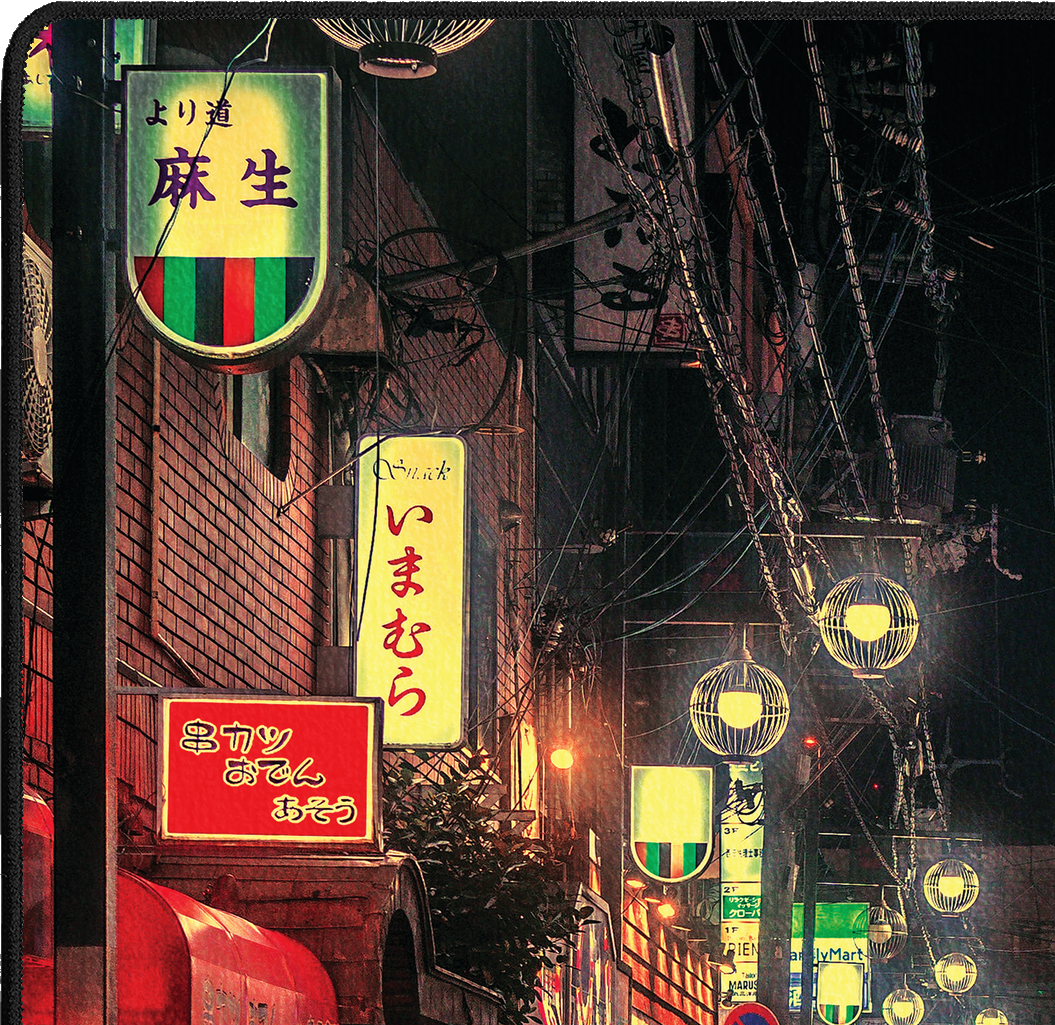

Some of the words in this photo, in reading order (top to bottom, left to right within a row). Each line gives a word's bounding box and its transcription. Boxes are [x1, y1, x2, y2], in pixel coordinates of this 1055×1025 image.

[144, 98, 234, 129] より道
[147, 146, 299, 210] 麻生
[382, 503, 433, 717] いまむら
[180, 718, 293, 756] 串カツ
[223, 757, 326, 788] おでん
[271, 795, 358, 824] あそう
